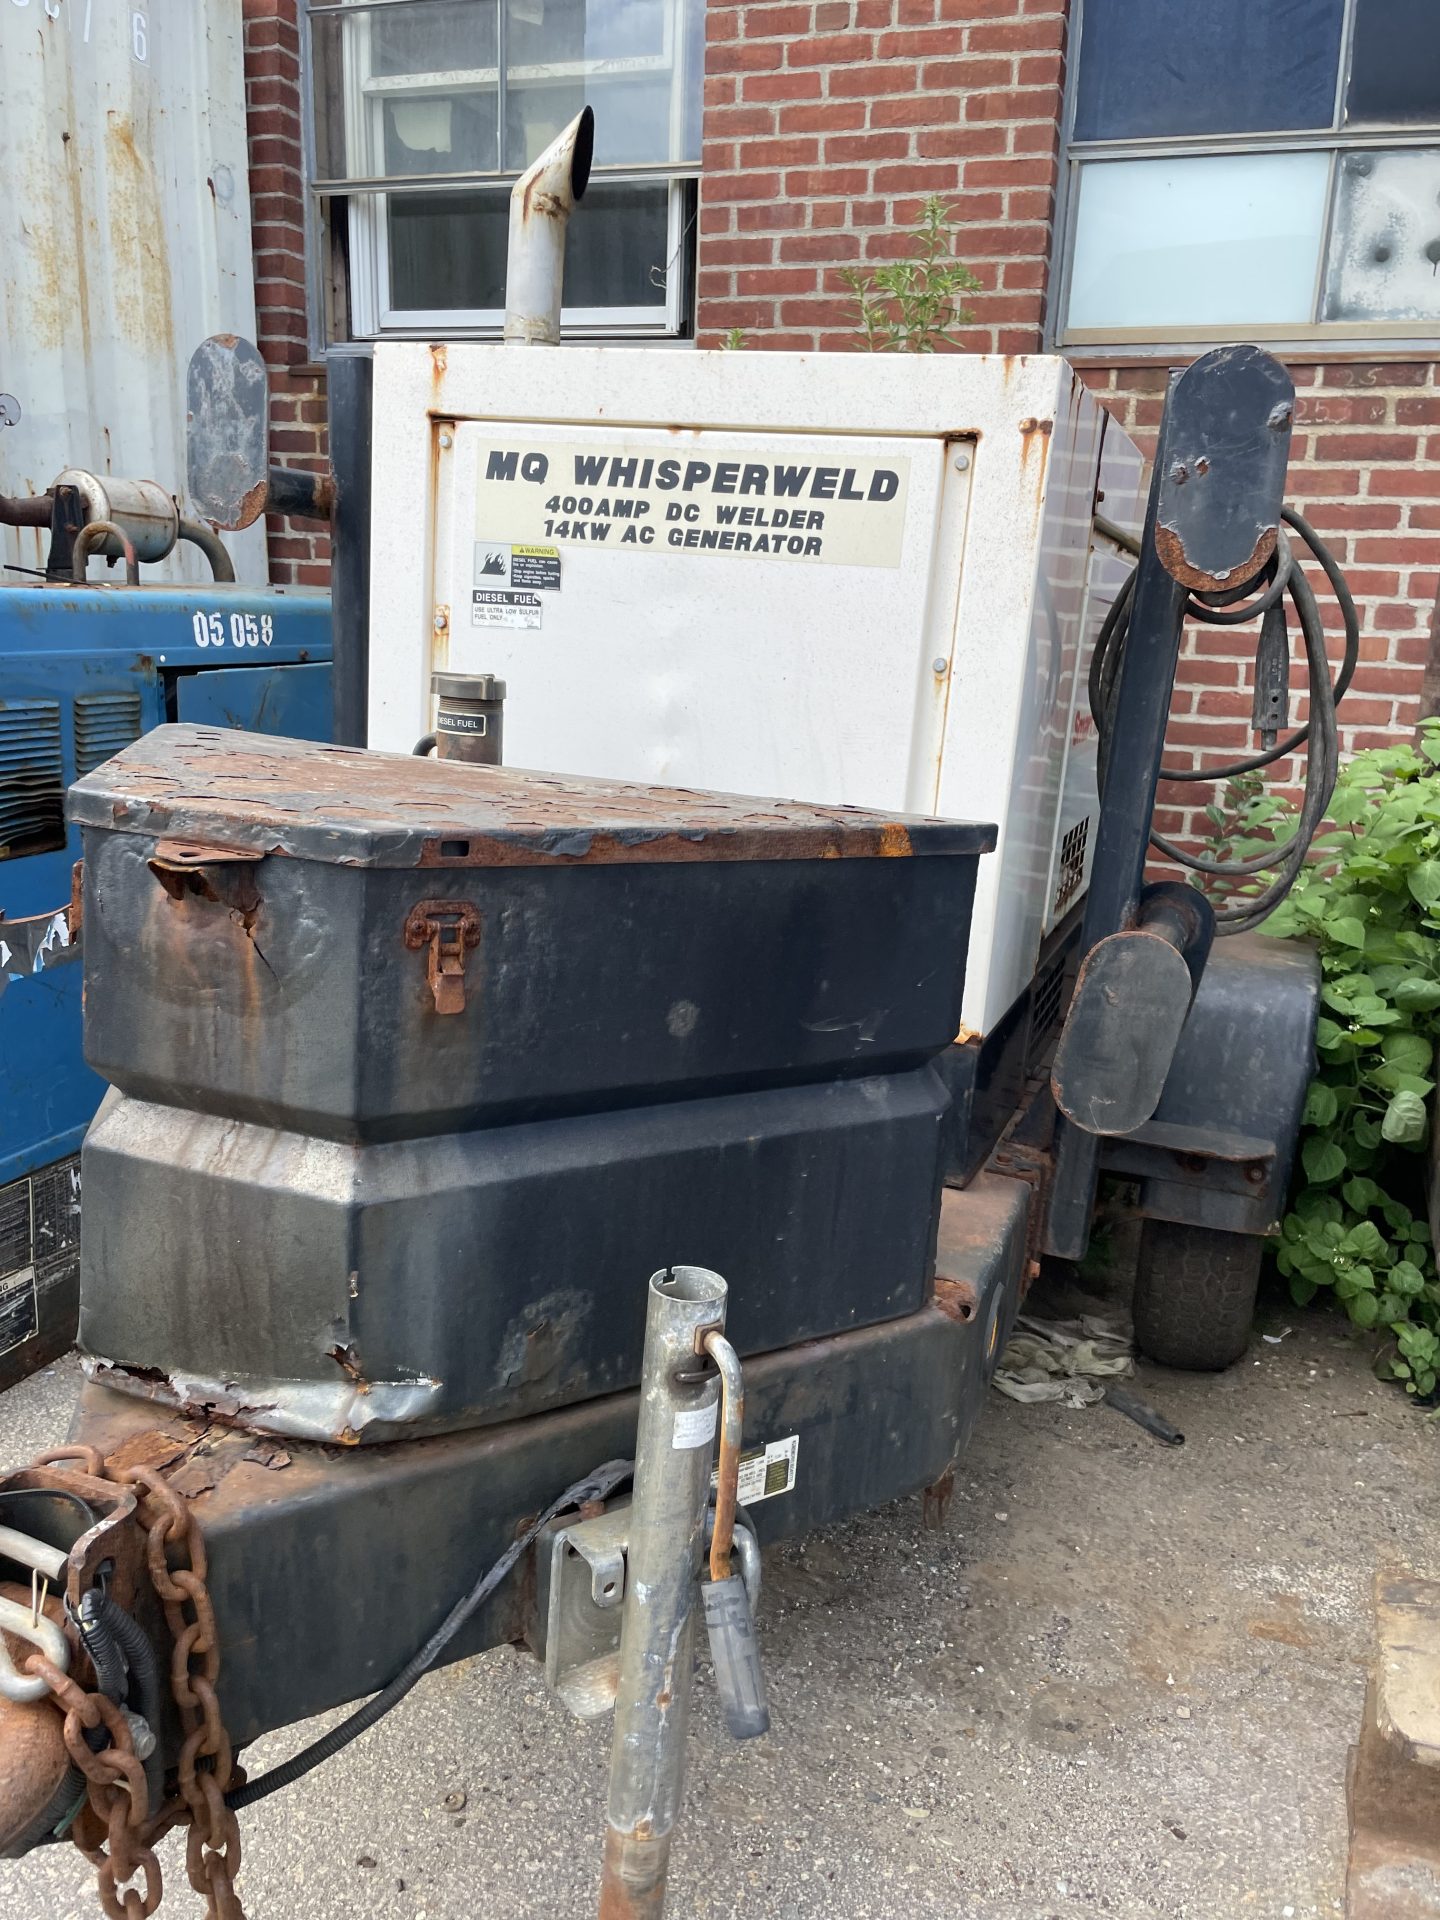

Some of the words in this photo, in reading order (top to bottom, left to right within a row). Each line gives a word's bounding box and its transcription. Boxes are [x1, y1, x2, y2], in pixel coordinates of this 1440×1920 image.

[485, 450, 549, 485] MQ
[574, 455, 900, 502] WHISPERWELD
[544, 495, 651, 519] 400AMP
[665, 502, 701, 523] DC
[716, 505, 826, 530] WELDER
[525, 548, 555, 556] WARNING
[543, 519, 612, 541] 14KW
[620, 525, 656, 545] AC
[667, 528, 824, 556] GENERATOR
[475, 593, 509, 603] DIESEL
[513, 594, 538, 605] FUEL
[192, 610, 225, 648] 05
[230, 613, 274, 648] 058
[457, 719, 478, 728] FUEL
